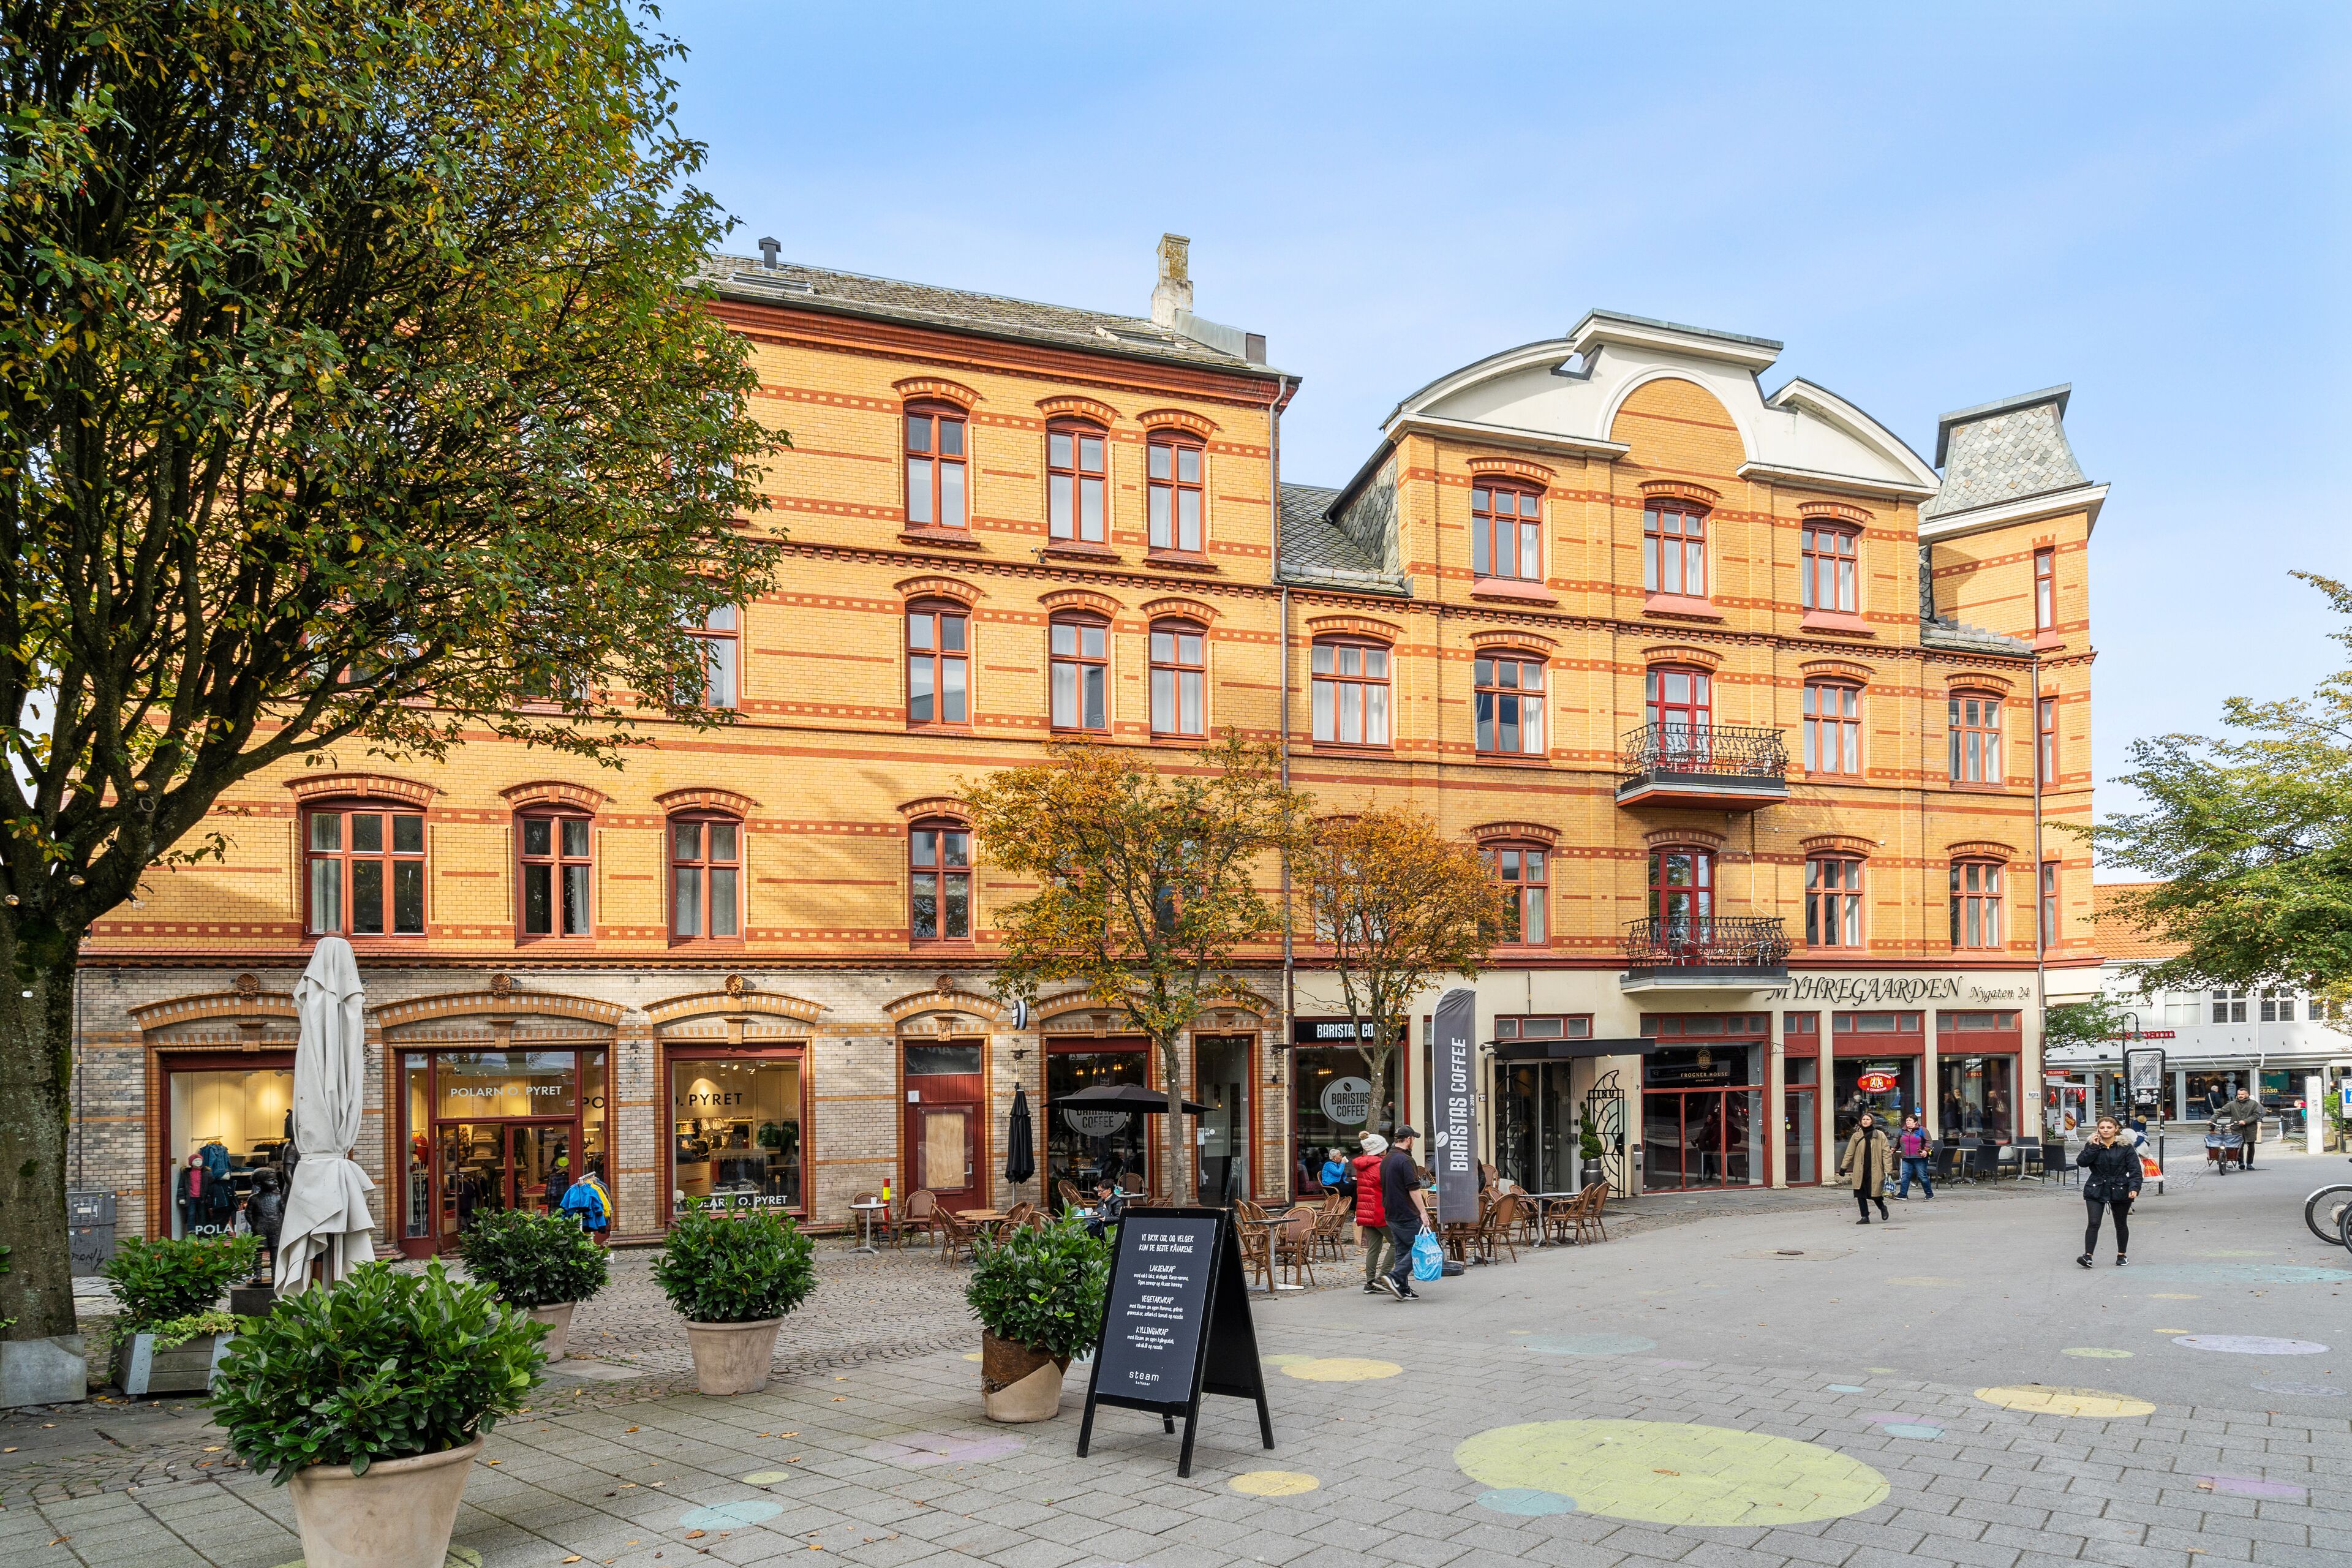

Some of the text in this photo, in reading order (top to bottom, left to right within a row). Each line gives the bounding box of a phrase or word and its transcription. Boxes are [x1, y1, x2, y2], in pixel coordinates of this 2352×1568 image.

[1767, 976, 1962, 1006] MYHREGAARDEN
[1969, 986, 2030, 1003] Nygaten 24
[1317, 1024, 1357, 1038] BARISTA
[451, 1086, 562, 1098] POLARN O. PYRET
[689, 1093, 742, 1106] PYRET
[1332, 1092, 1370, 1105] BARISTAS
[1449, 1037, 1468, 1171] BARISTAS COFFEE
[1337, 1105, 1365, 1117] COFFEE
[1082, 1116, 1114, 1128] COFFEE
[755, 1195, 788, 1205] PYRET
[195, 1224, 236, 1235] POLA
[1170, 1243, 1193, 1253] RÅVARENE
[1136, 1325, 1169, 1336] KYLLINGWRAP
[1129, 1371, 1159, 1382] steam
